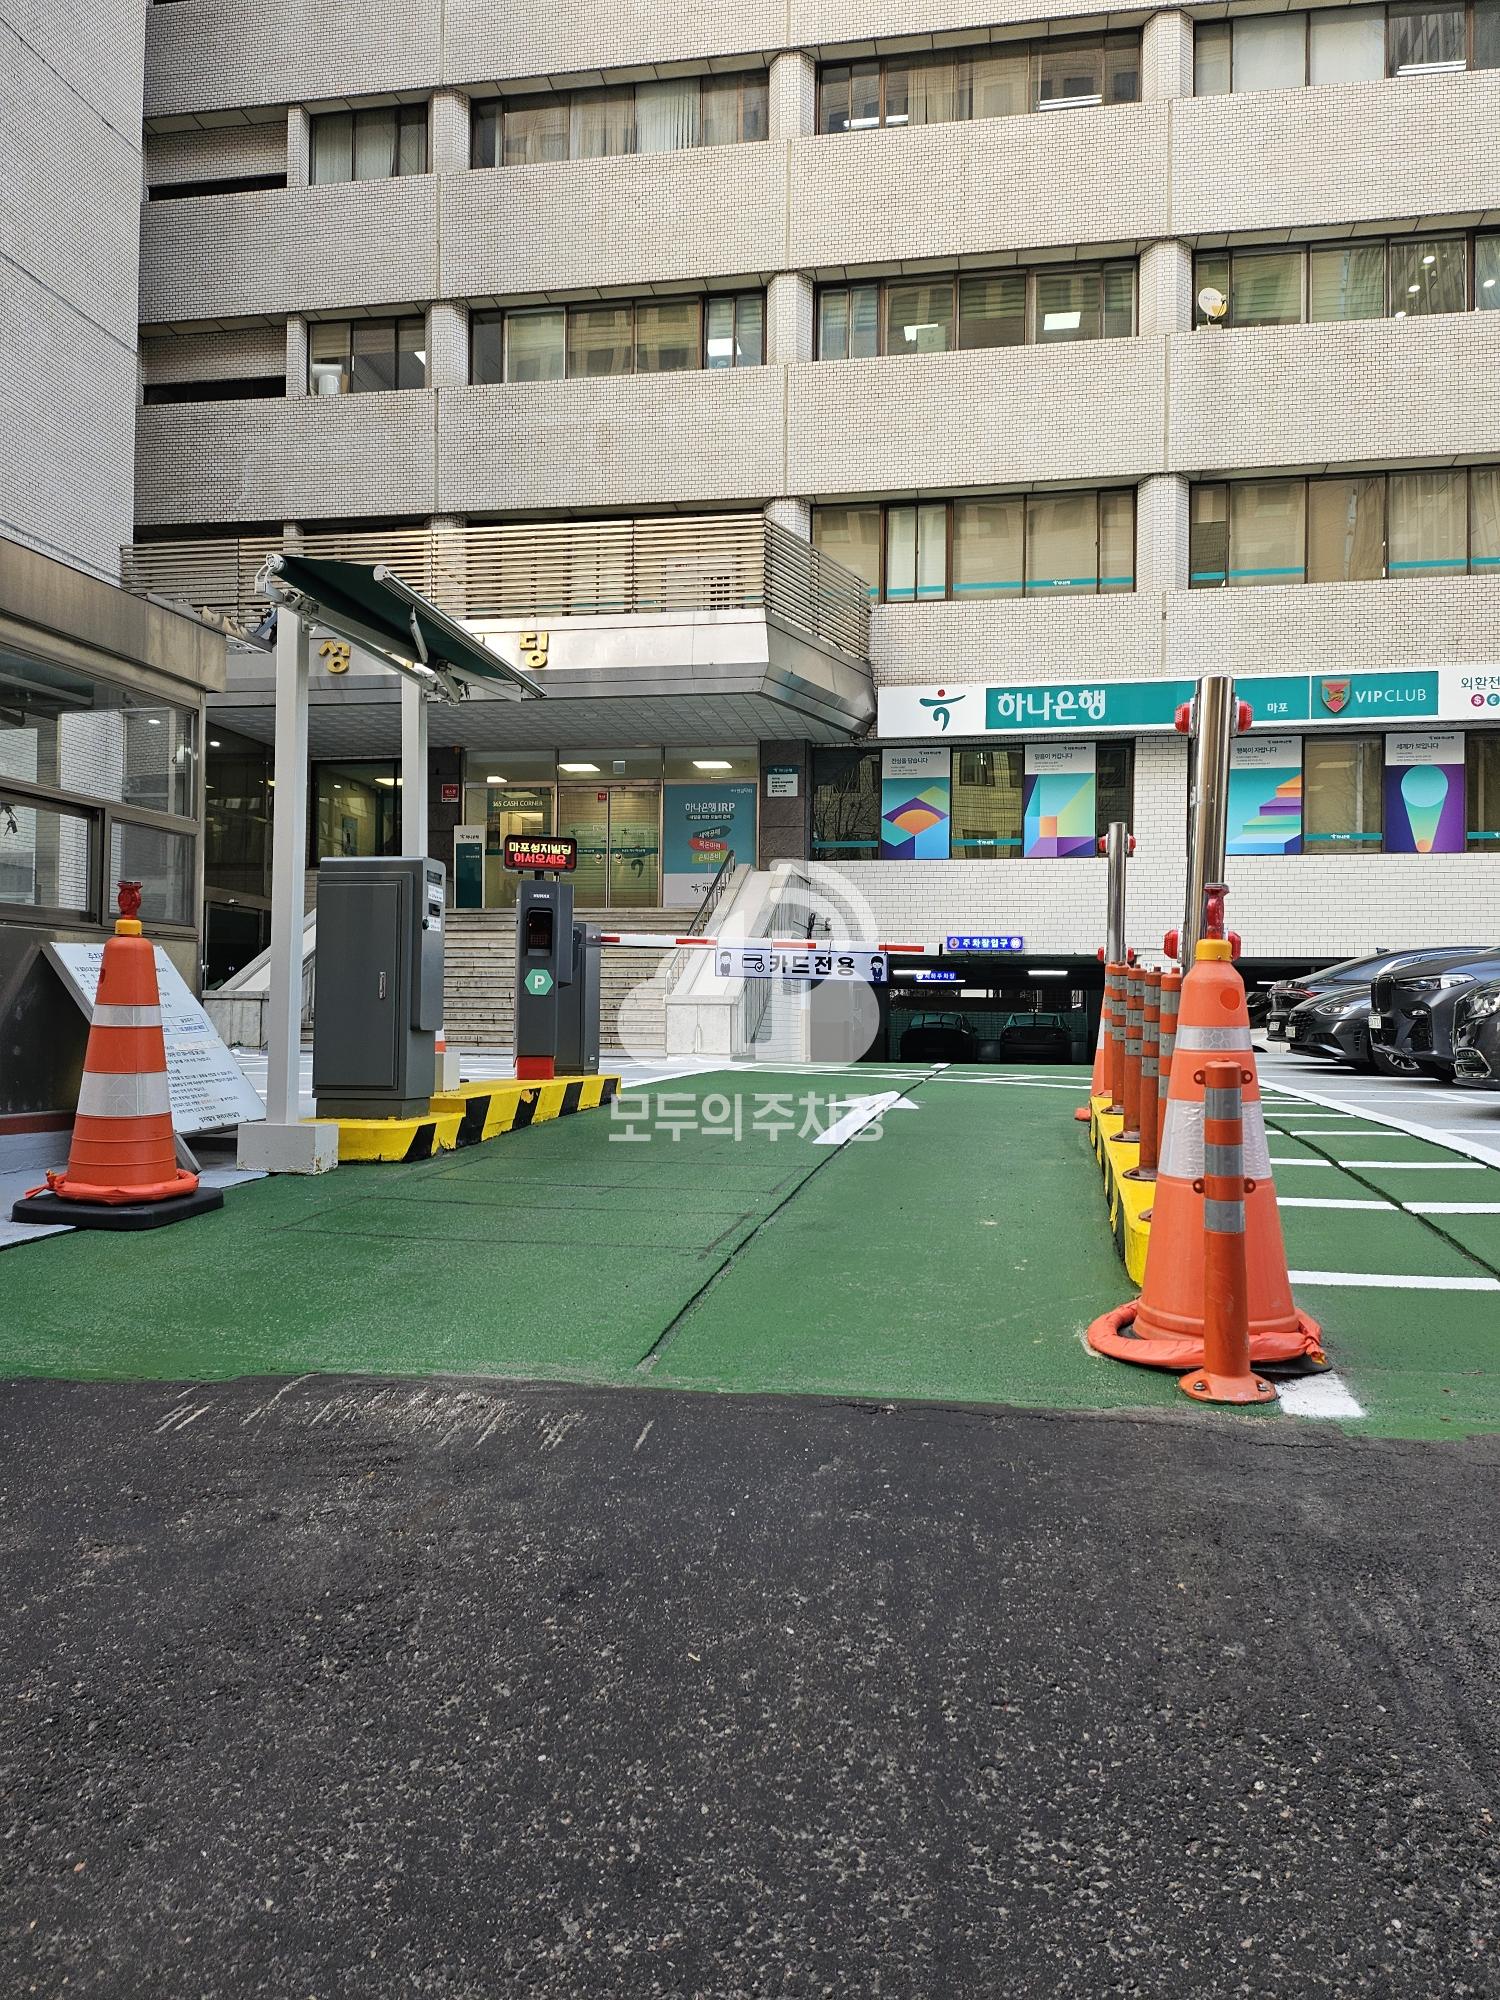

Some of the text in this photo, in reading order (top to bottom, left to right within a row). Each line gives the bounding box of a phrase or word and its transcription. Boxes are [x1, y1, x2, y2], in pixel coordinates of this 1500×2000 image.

[997, 690, 1106, 722] 하나은행
[1267, 702, 1289, 714] 마포
[508, 842, 572, 855] 마포성지빌딩
[962, 938, 1009, 949] 주차장입구
[769, 955, 854, 977] 카드전용
[924, 972, 955, 980] 지하주차장
